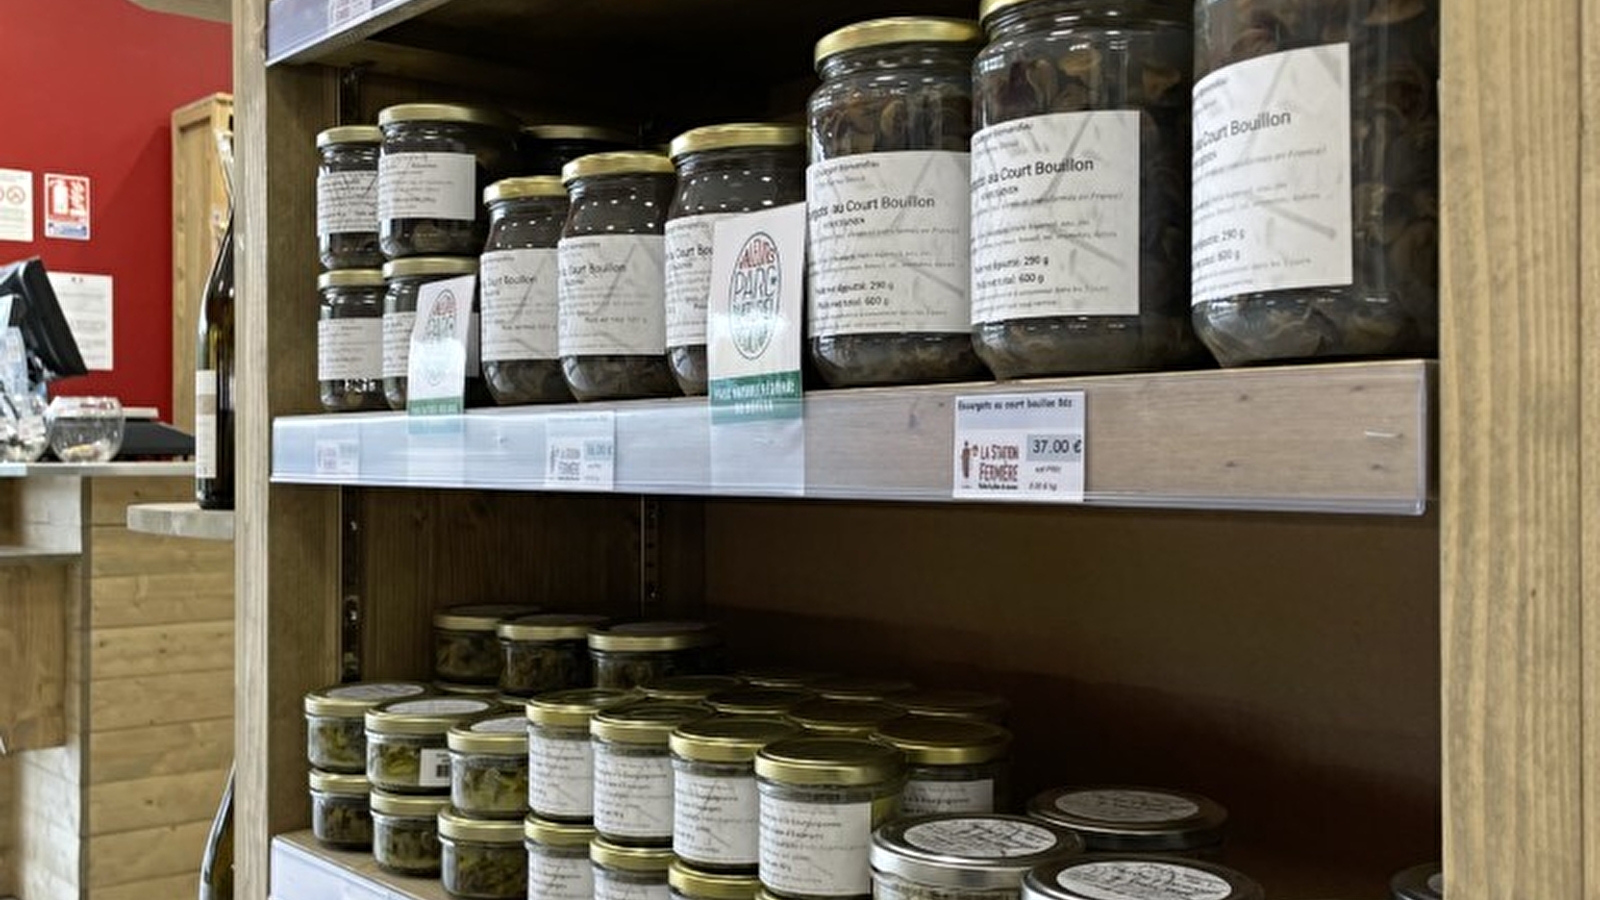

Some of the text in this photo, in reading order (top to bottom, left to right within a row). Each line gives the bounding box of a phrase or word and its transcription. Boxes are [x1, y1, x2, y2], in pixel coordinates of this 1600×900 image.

[1230, 110, 1292, 135] Bouillon
[1001, 164, 1033, 182] Court
[1035, 158, 1094, 176] Bouillon
[846, 198, 879, 213] Court
[881, 195, 935, 210] Bouillon
[588, 263, 626, 274] Bouillon
[1024, 255, 1041, 266] 290
[733, 265, 778, 303] PARC
[1019, 273, 1036, 284] 600
[980, 443, 1020, 460] LA STATION
[1032, 438, 1082, 455] 37.00 €
